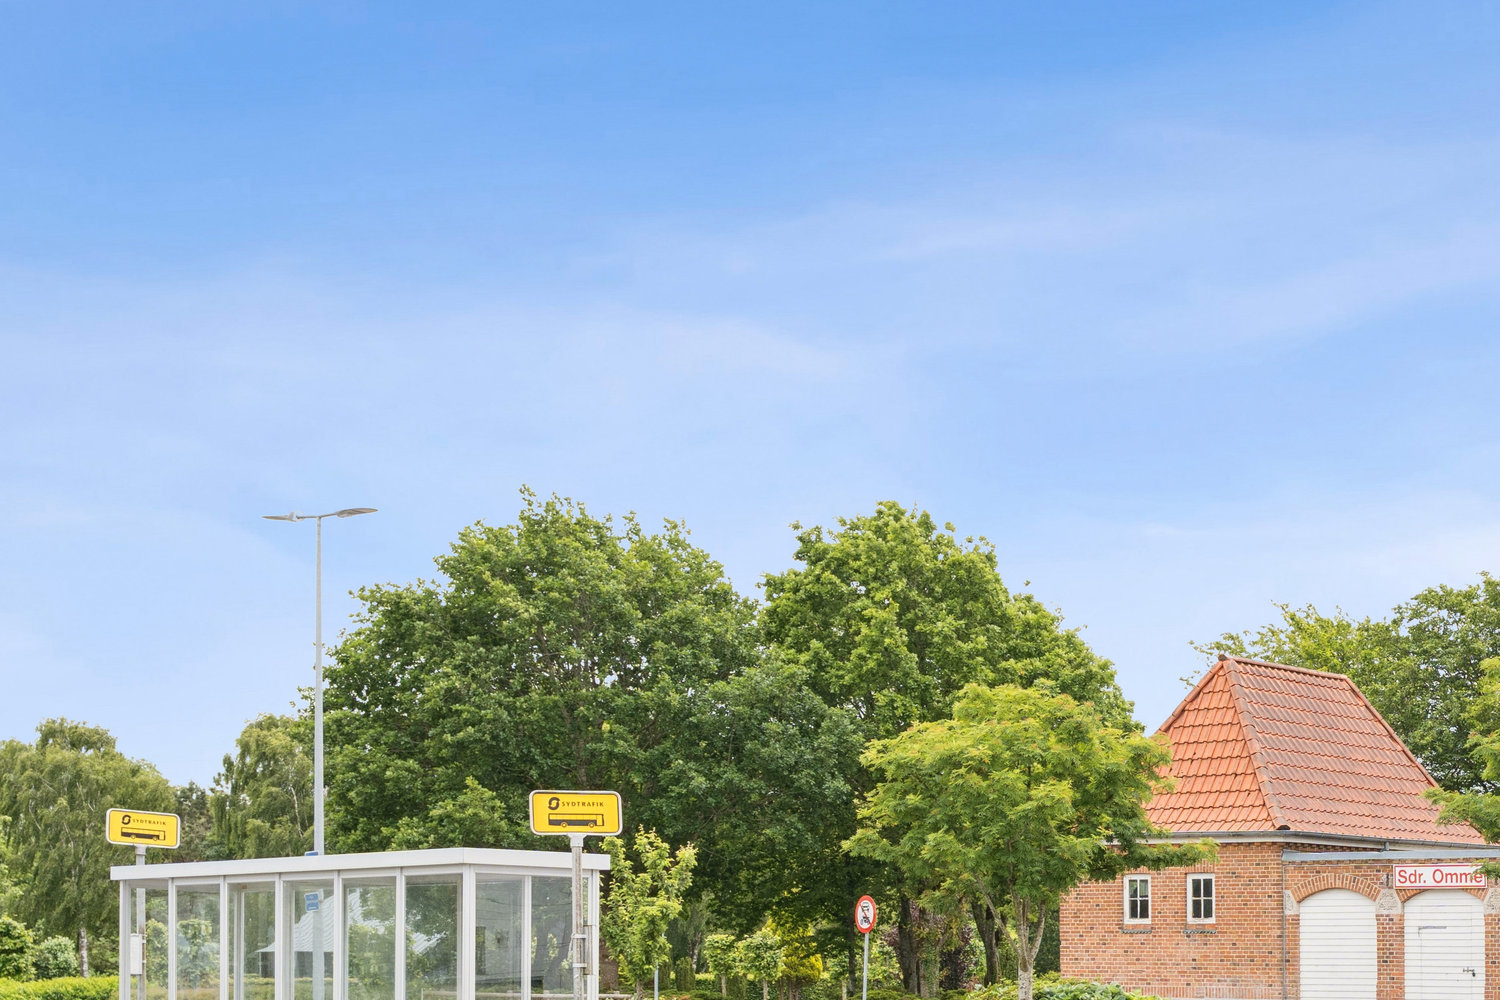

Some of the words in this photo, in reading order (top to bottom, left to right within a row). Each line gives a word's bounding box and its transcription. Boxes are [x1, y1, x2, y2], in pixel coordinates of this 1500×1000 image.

[132, 818, 166, 826] SYDTRAFIK
[1398, 869, 1426, 884] Sdr.
[1432, 868, 1483, 884] Omme
